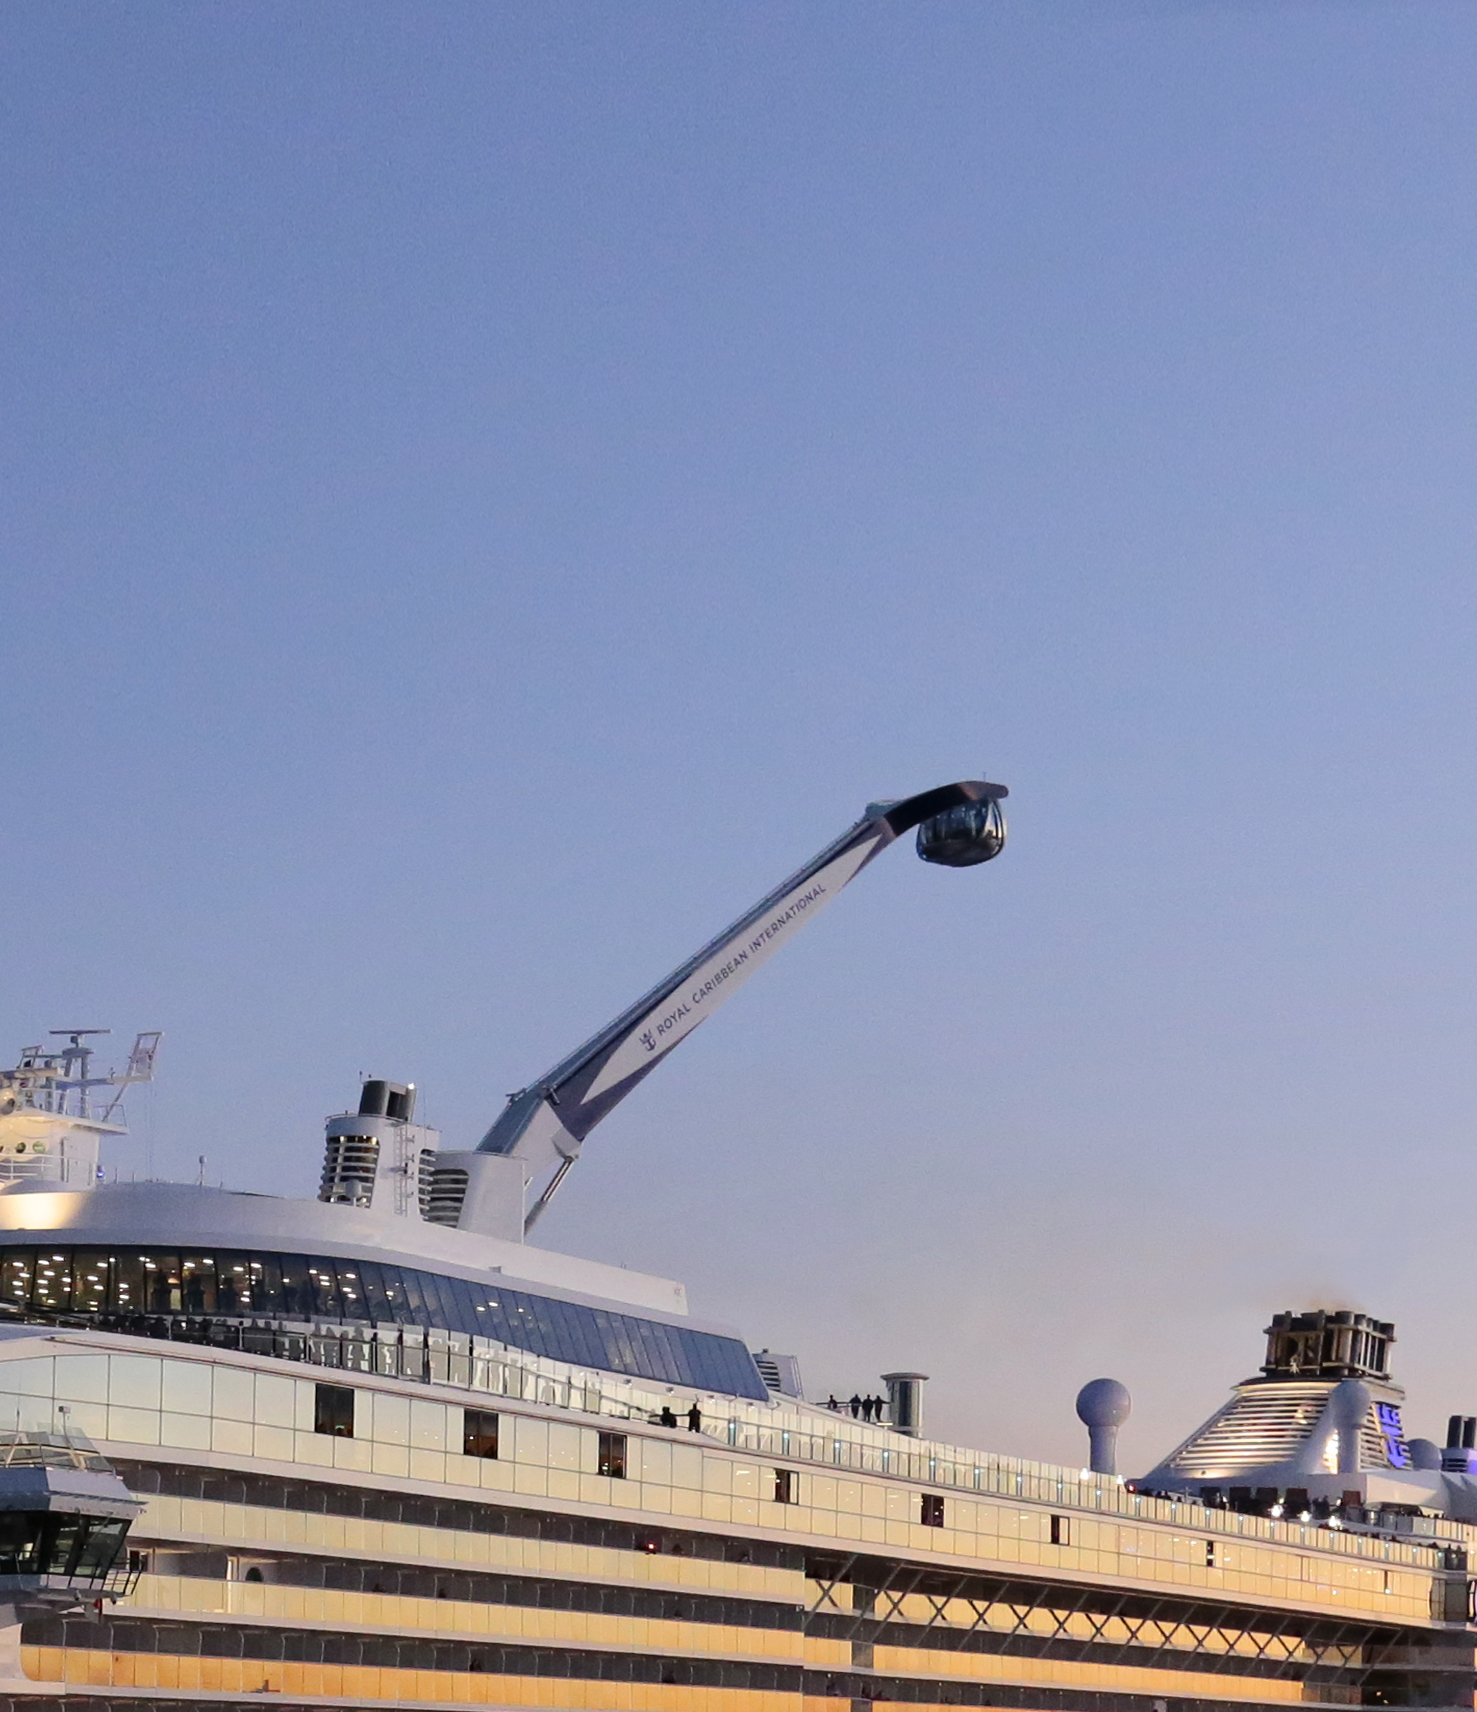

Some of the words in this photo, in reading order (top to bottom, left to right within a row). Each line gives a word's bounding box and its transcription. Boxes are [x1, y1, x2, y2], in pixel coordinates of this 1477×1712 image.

[656, 1002, 692, 1036] ROYAL
[692, 950, 748, 1005] CARIBBEAN
[749, 884, 827, 953] INTERNATIONAL
